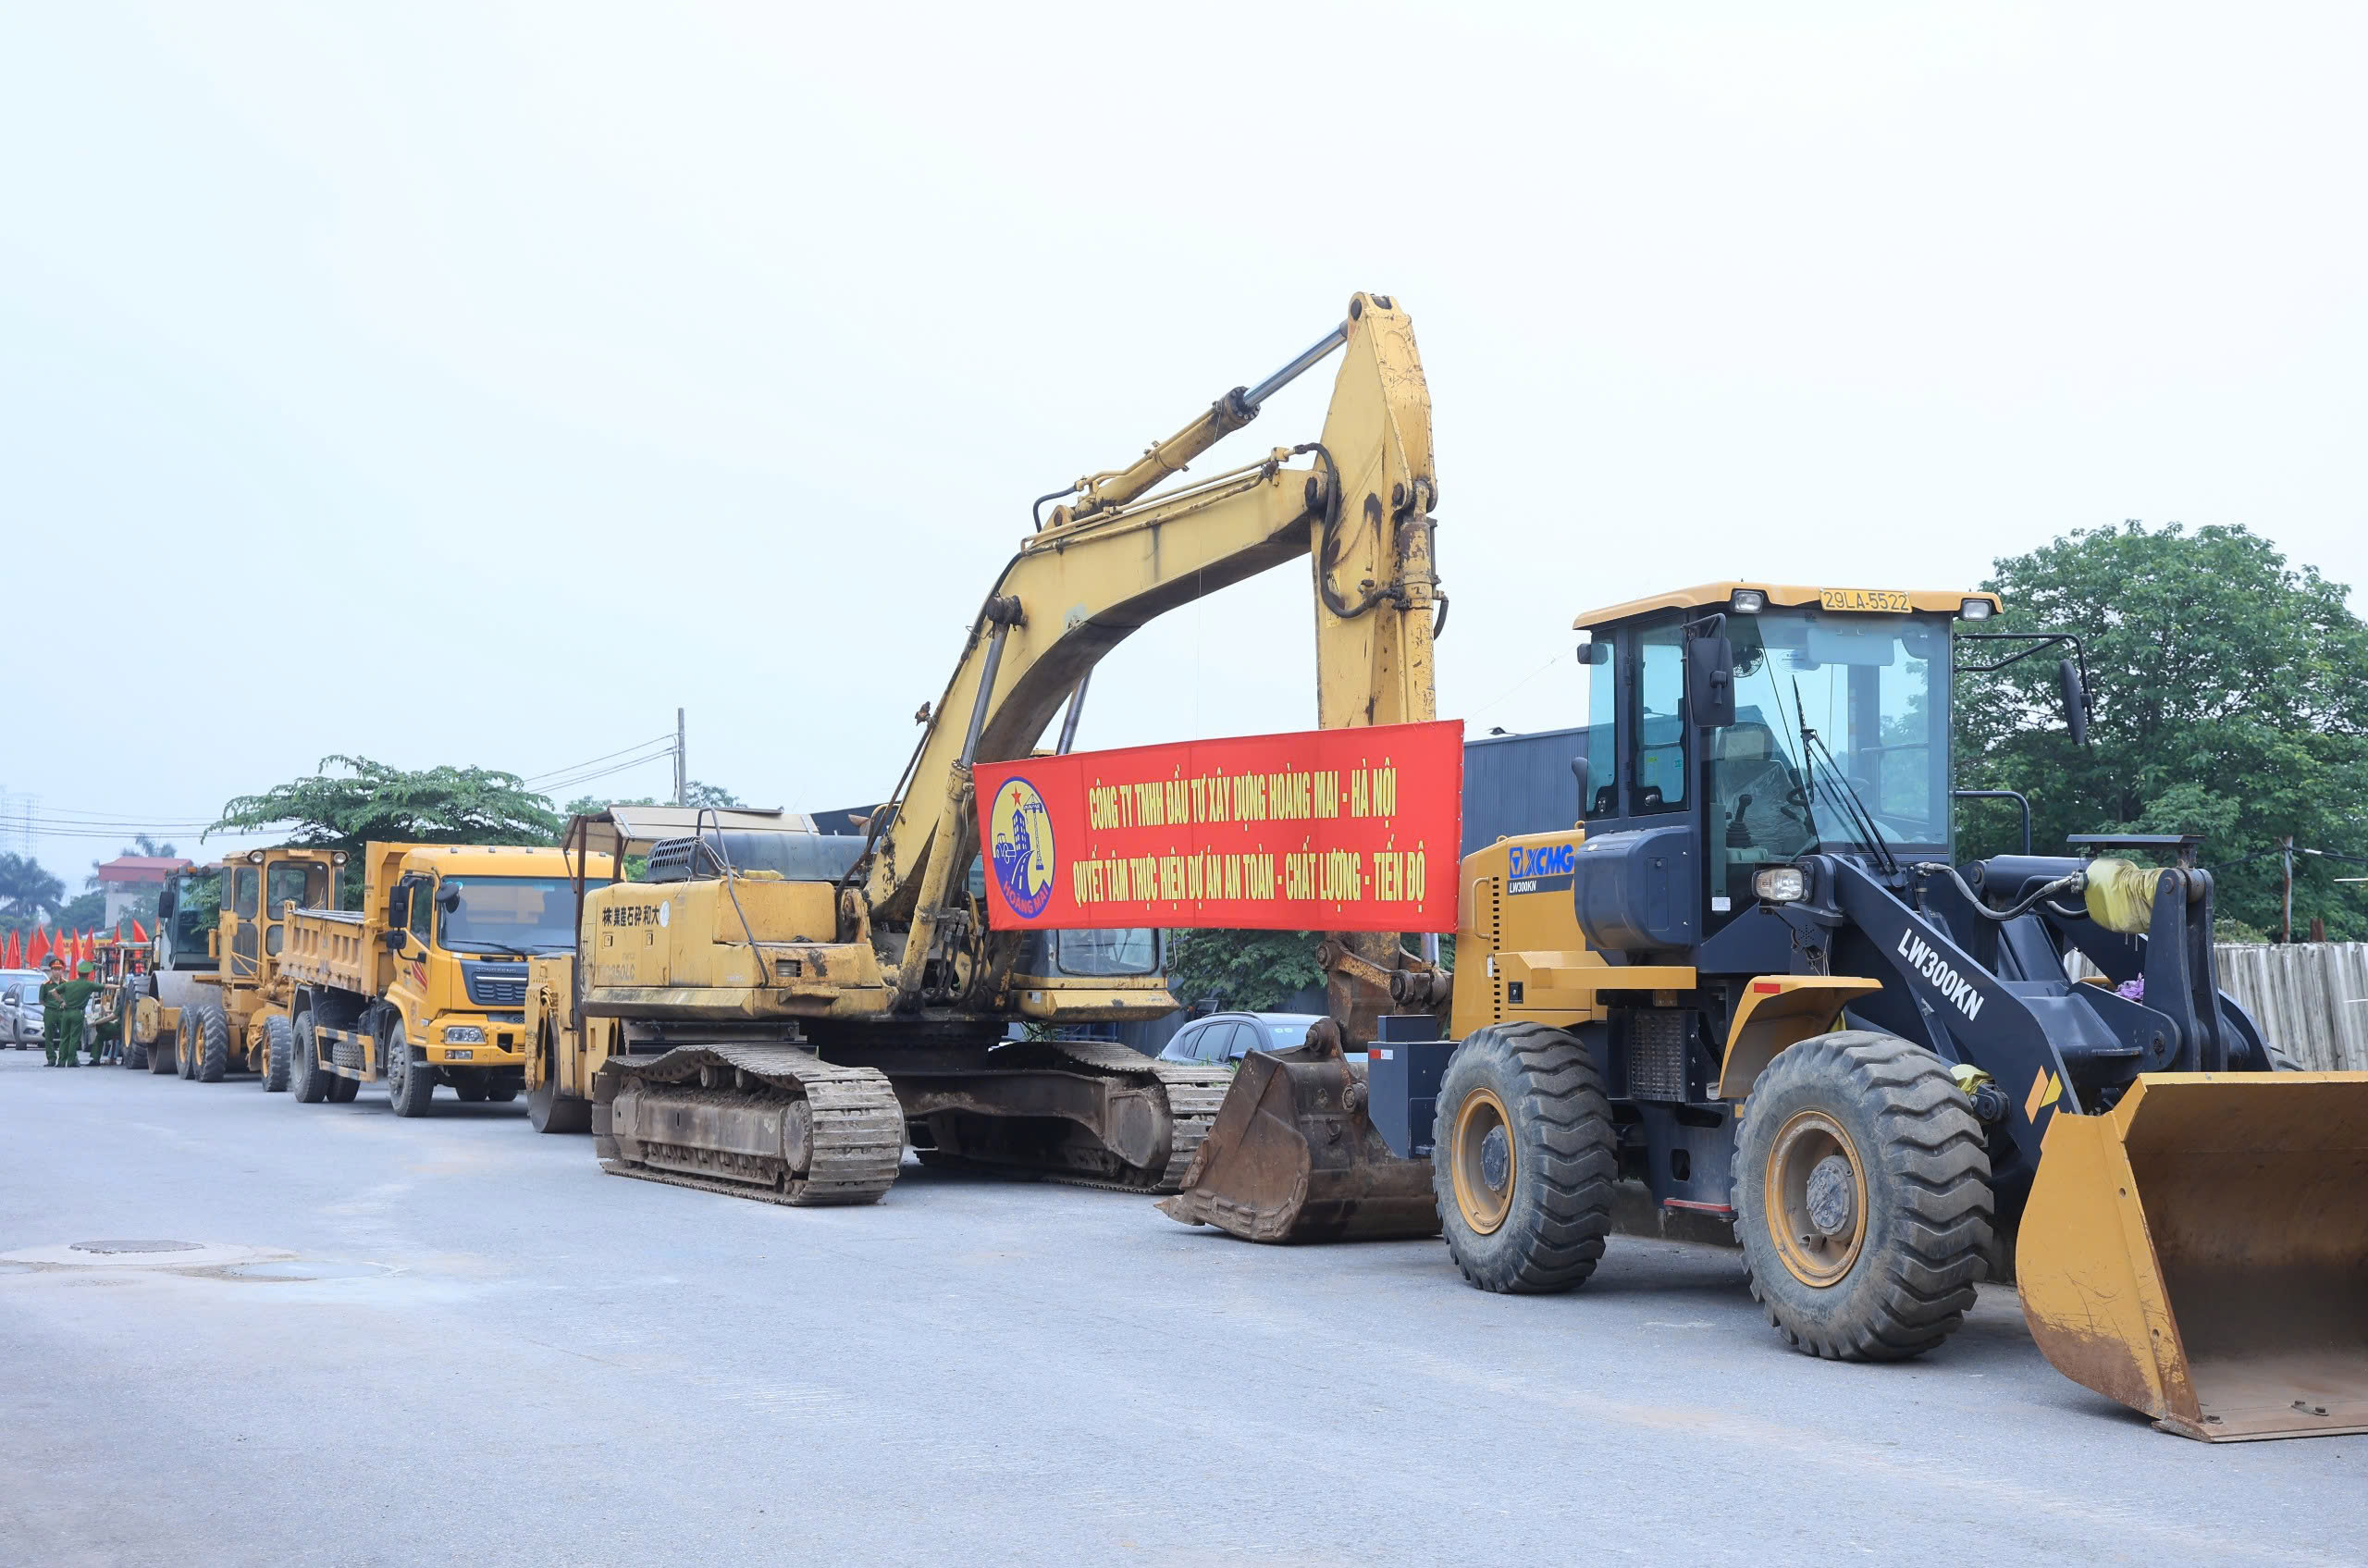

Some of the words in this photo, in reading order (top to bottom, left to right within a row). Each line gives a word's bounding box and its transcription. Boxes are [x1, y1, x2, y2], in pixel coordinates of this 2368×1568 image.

[1823, 591, 1909, 611] 29LA-5522
[1089, 777, 1119, 831] CÔNG
[1118, 784, 1133, 828] TY
[1134, 781, 1165, 827] TNHH
[1166, 763, 1190, 825] ĐẦU
[1190, 772, 1207, 824] TƯ
[1207, 766, 1231, 822] XÂY
[1233, 770, 1266, 832] DỰNG
[1268, 762, 1311, 821] HOÀNG
[1314, 770, 1338, 819] MAI
[1350, 758, 1370, 818] HÀ
[1372, 756, 1397, 829] NỘI
[1072, 844, 1104, 908] QUYẾT
[1104, 849, 1129, 902] TÂM
[1128, 852, 1158, 911] THỰC
[1159, 846, 1187, 911] HIỆN
[1187, 850, 1204, 910] DỰ
[1205, 844, 1223, 900] ÁN
[1225, 854, 1241, 900] AN
[1242, 843, 1275, 901] TOÀN
[1285, 834, 1316, 901] CHẤT
[1319, 847, 1362, 913] LƯỢNG
[1373, 833, 1403, 902] TIẾN
[1406, 840, 1425, 913] ĐỘ
[1524, 844, 1575, 877] XCMG
[1034, 885, 1049, 910] MAI
[1509, 880, 1536, 894] LW300KN
[1897, 927, 1985, 1022] LW300KN
